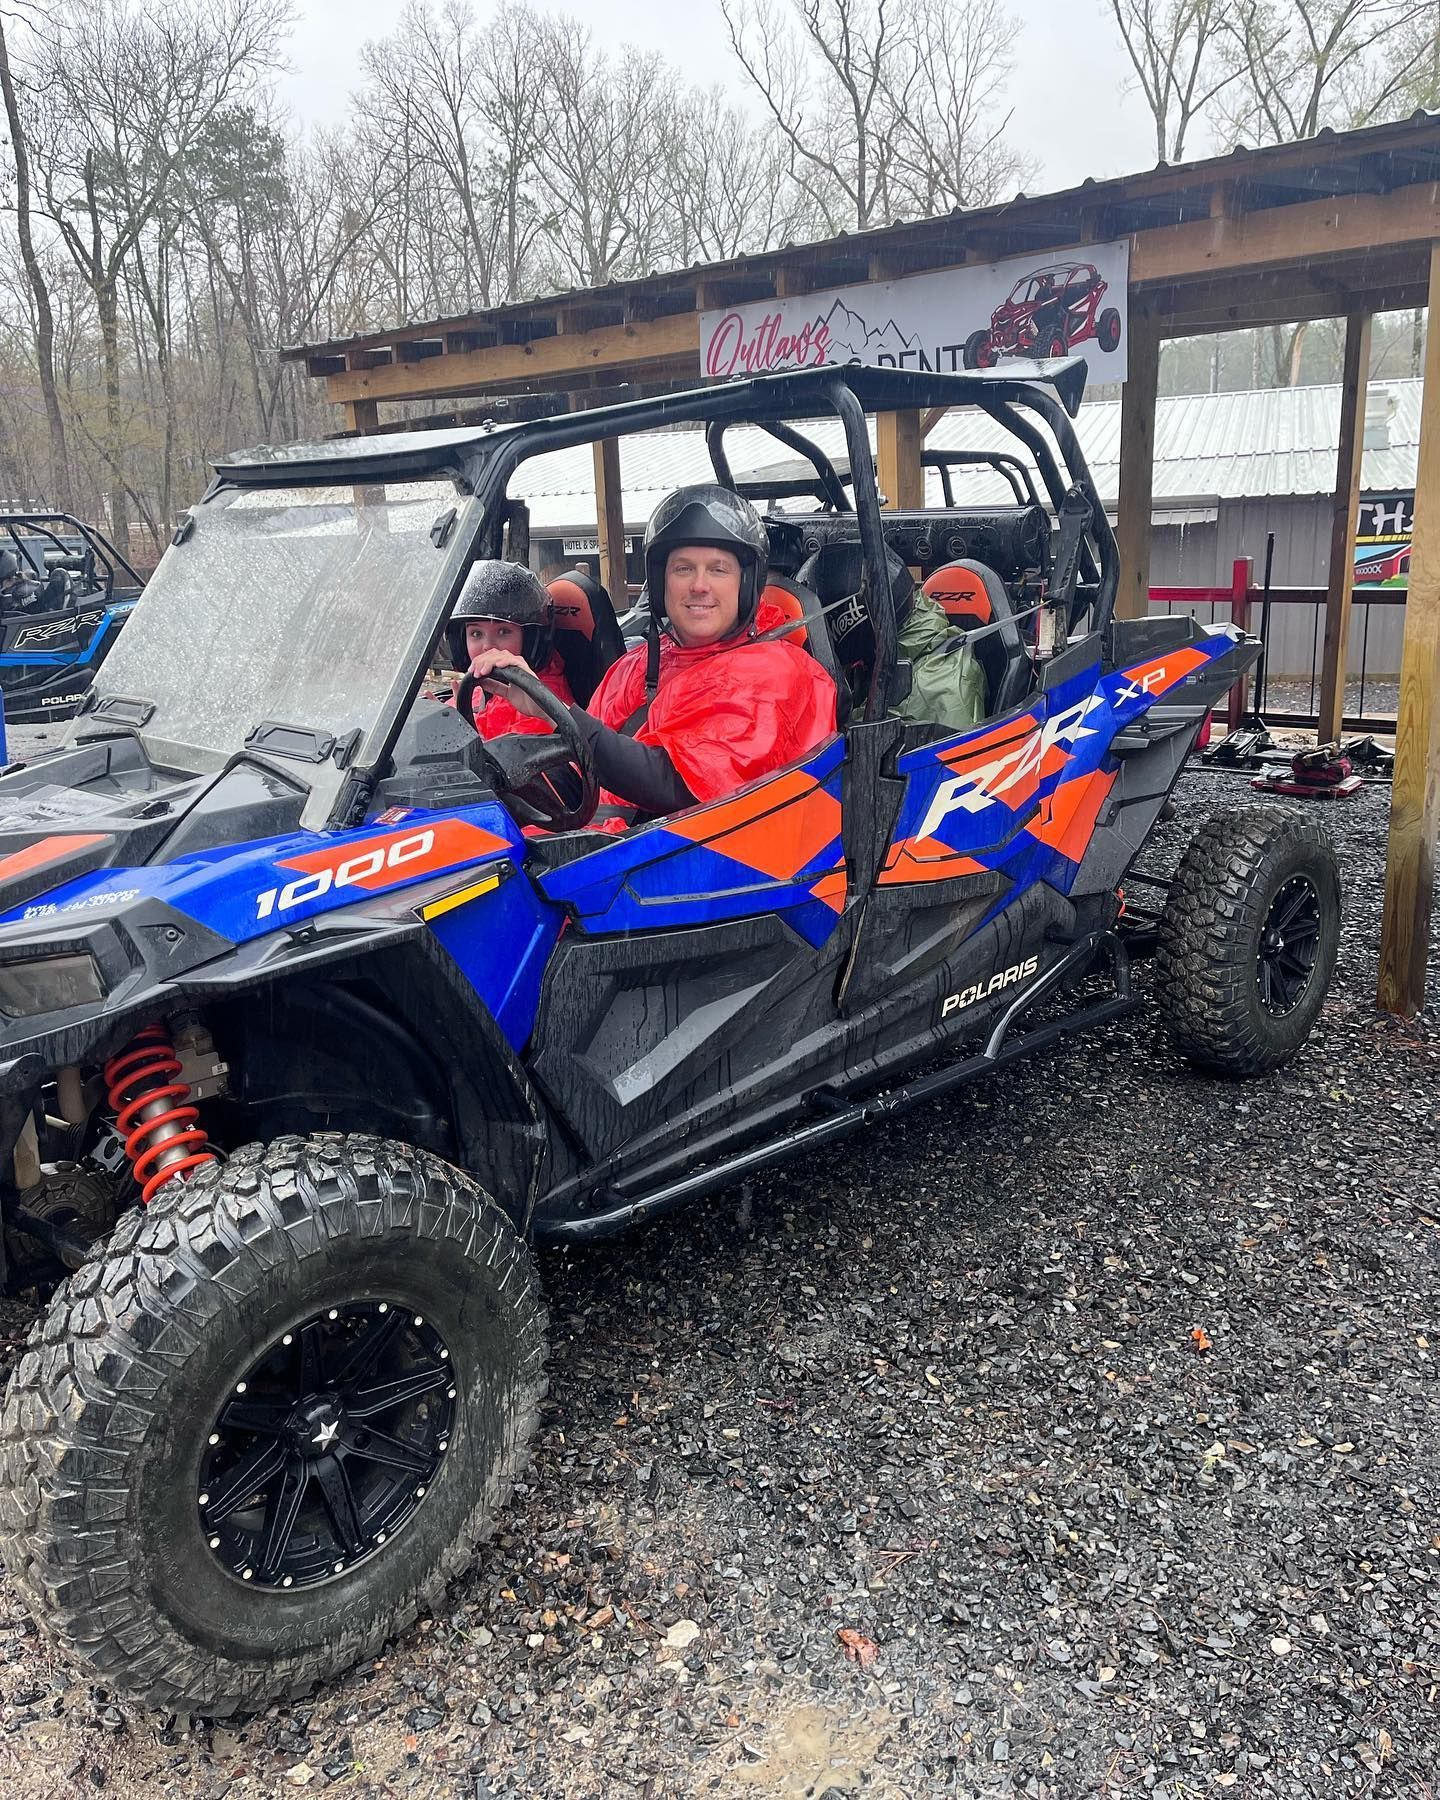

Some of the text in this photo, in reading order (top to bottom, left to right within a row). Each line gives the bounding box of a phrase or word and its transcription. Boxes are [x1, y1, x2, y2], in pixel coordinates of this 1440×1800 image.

[706, 312, 832, 376] Outlaws
[564, 540, 582, 550] HOTEL
[583, 539, 589, 549] &
[552, 605, 581, 617] ZR
[929, 591, 976, 602] RZR
[14, 609, 105, 648] RZR
[1113, 667, 1166, 709] XP
[914, 694, 1106, 844] RZR
[256, 829, 435, 920] 1000
[941, 955, 1039, 1018] POLARIS
